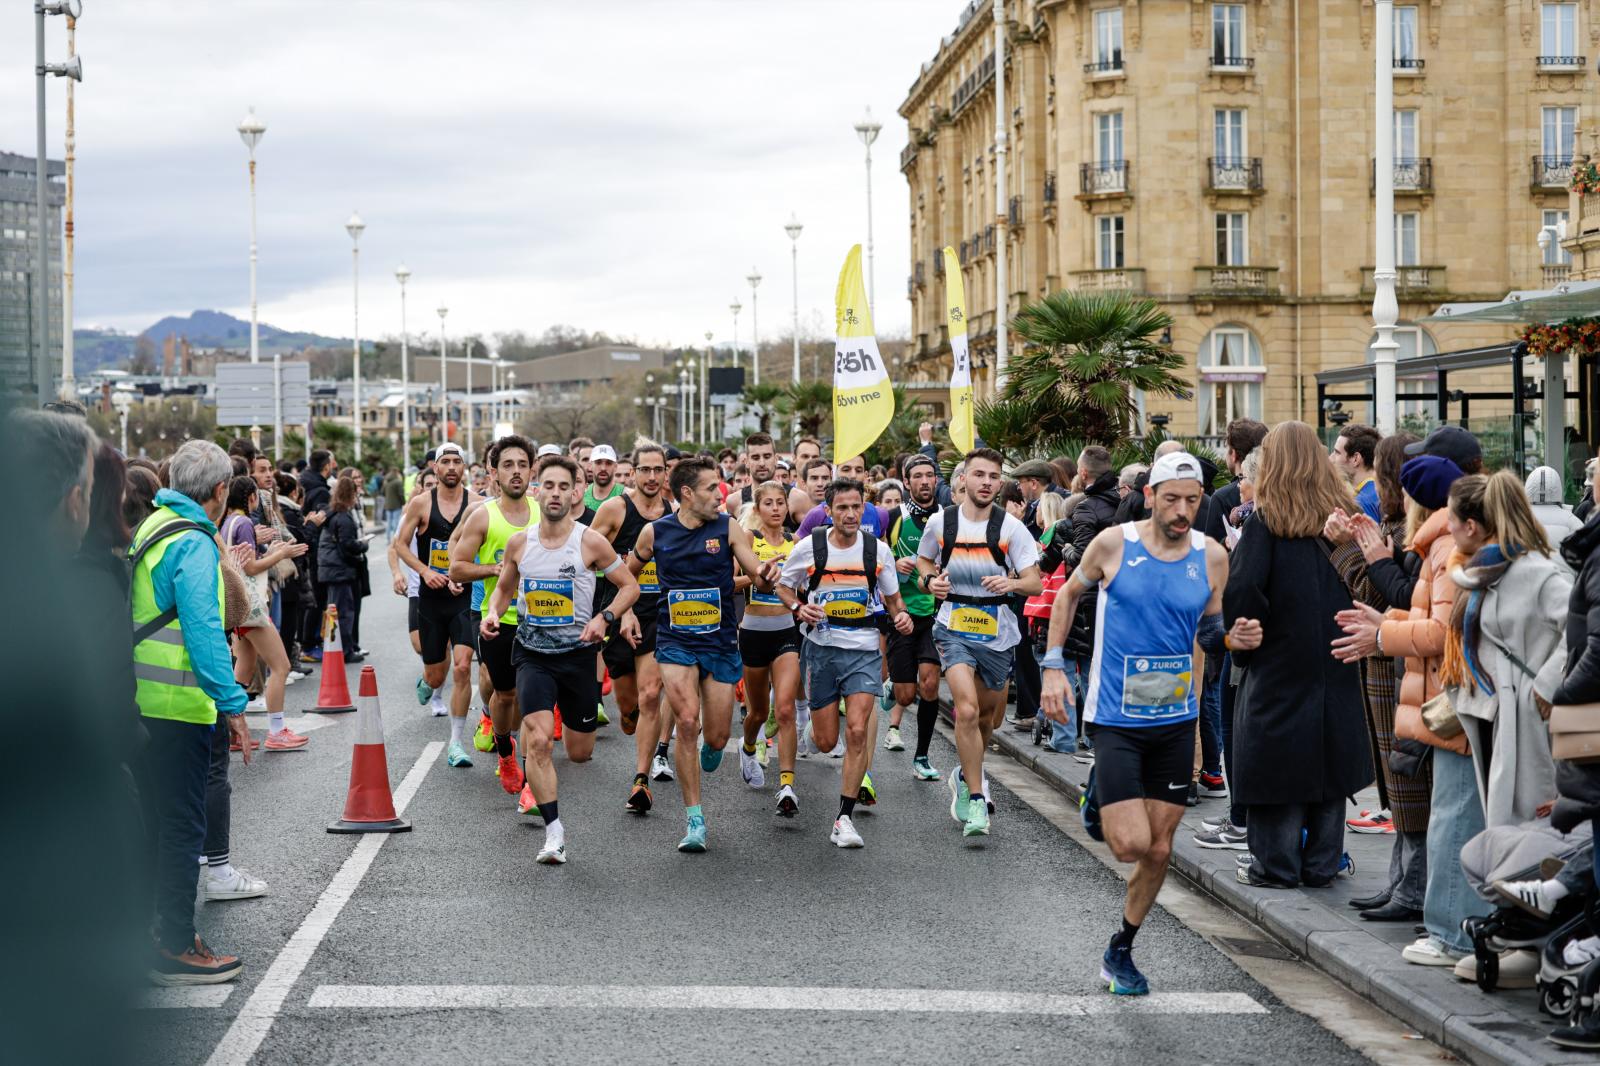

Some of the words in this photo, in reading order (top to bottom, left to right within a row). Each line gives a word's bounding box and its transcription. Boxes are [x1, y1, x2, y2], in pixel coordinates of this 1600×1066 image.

[861, 392, 880, 403] me
[836, 591, 862, 599] ZURICH
[534, 598, 565, 607] BEÑAT
[676, 609, 719, 617] ALEJANDRO
[832, 606, 861, 616] RUBÉN
[962, 616, 989, 625] JAIME
[1151, 661, 1184, 670] ZURICH
